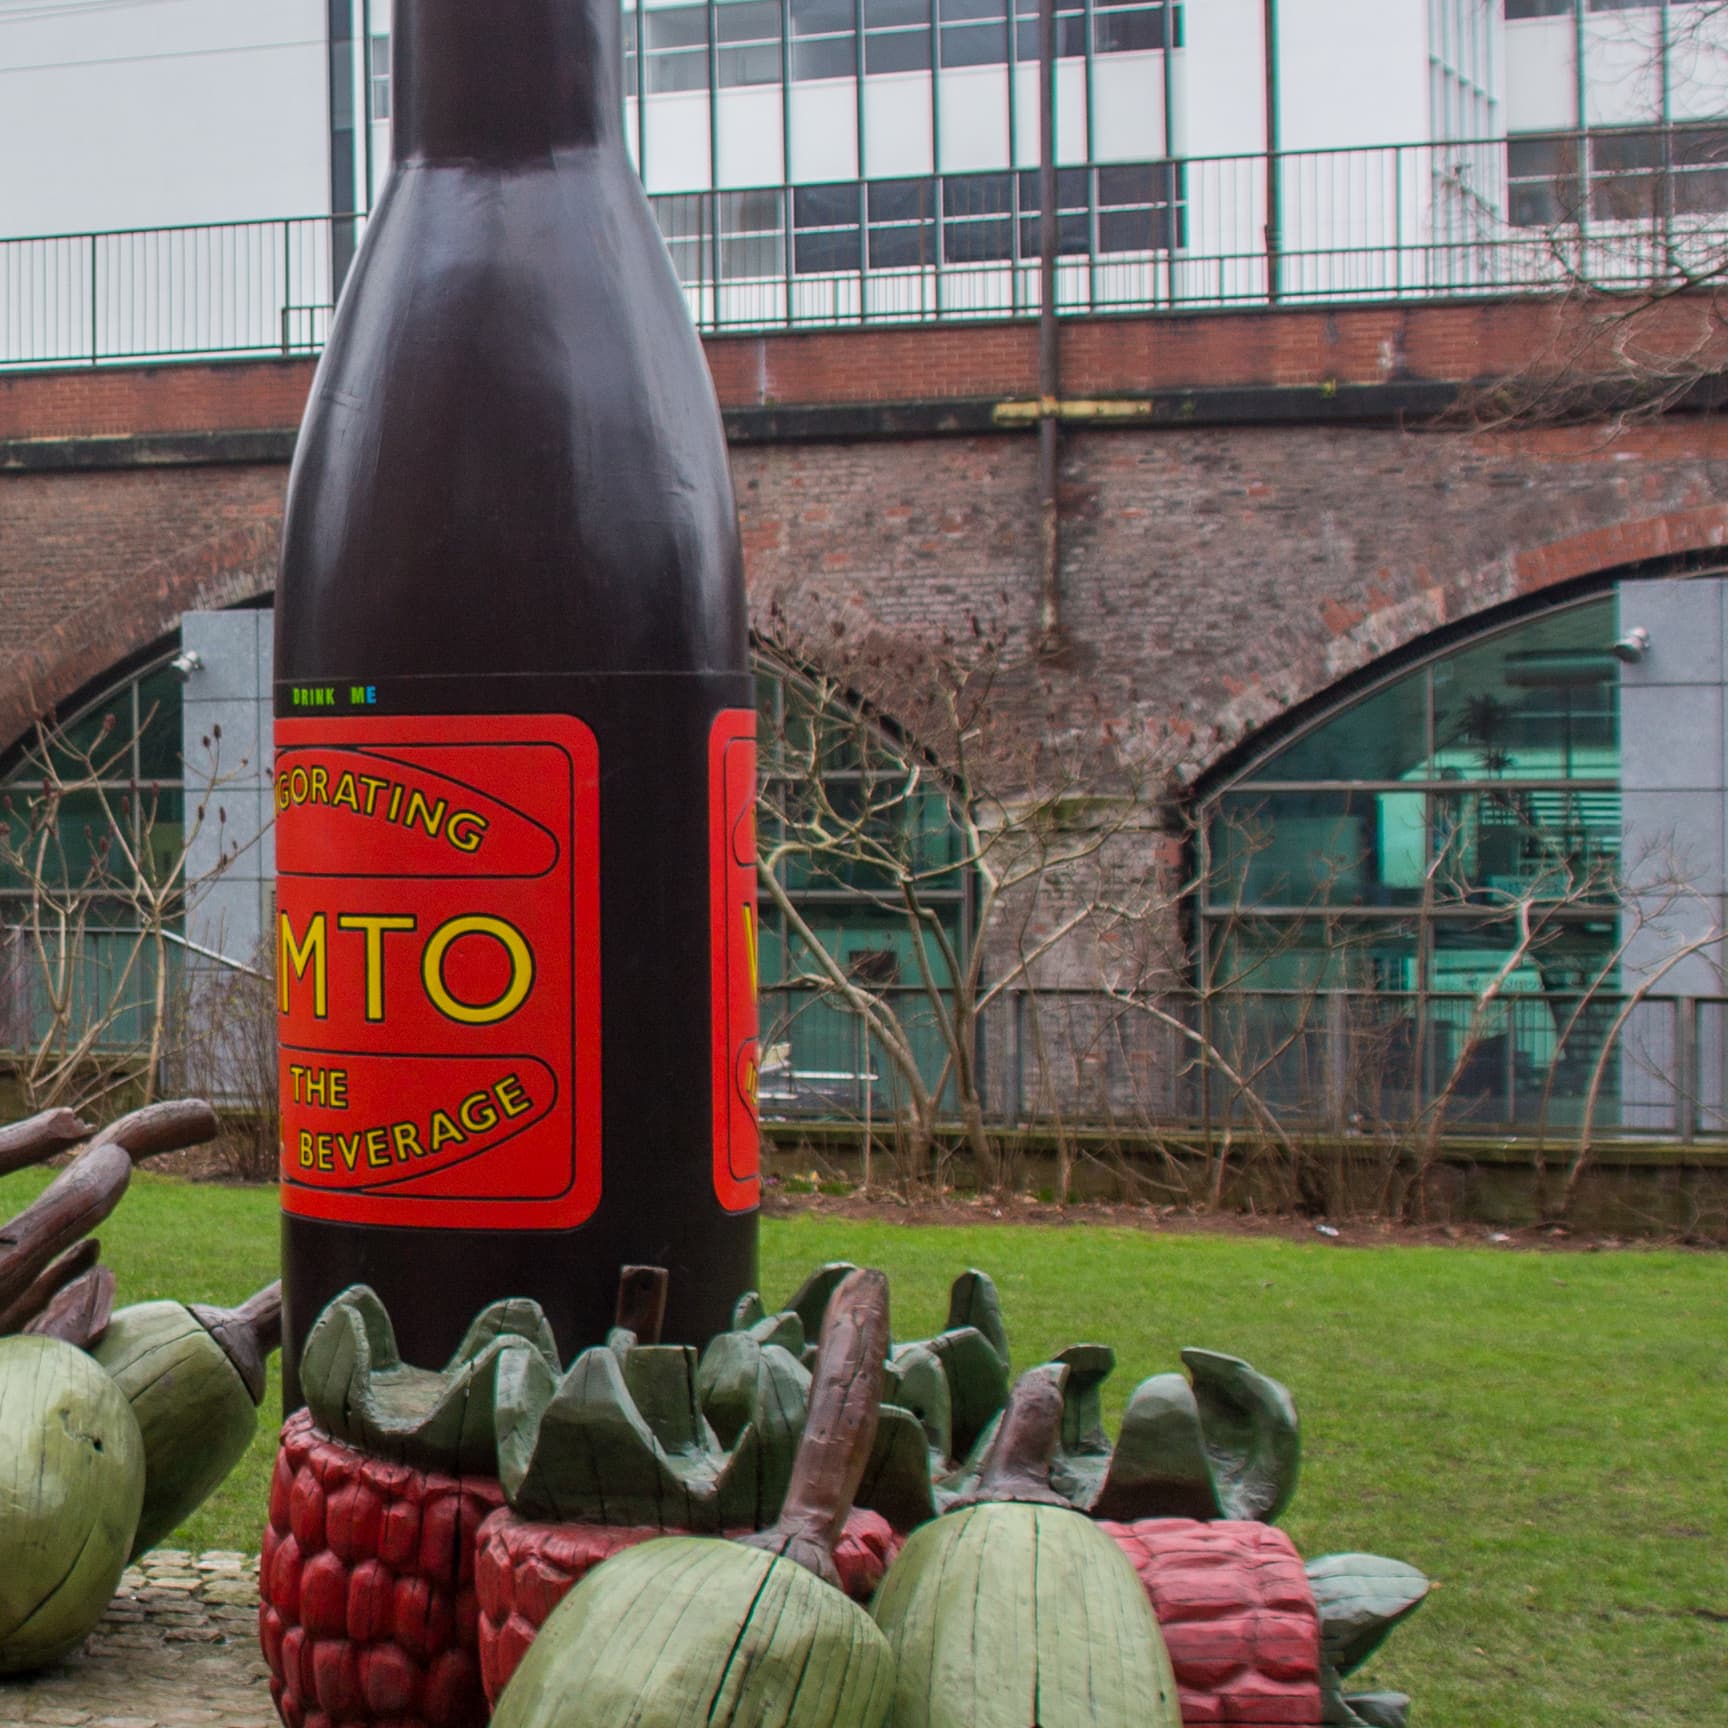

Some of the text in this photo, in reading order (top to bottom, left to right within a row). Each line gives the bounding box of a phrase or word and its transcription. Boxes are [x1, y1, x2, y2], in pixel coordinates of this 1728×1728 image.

[292, 686, 376, 706] DRINK ME
[290, 1064, 348, 1108] THE
[299, 1073, 533, 1171] BEVERAGE
